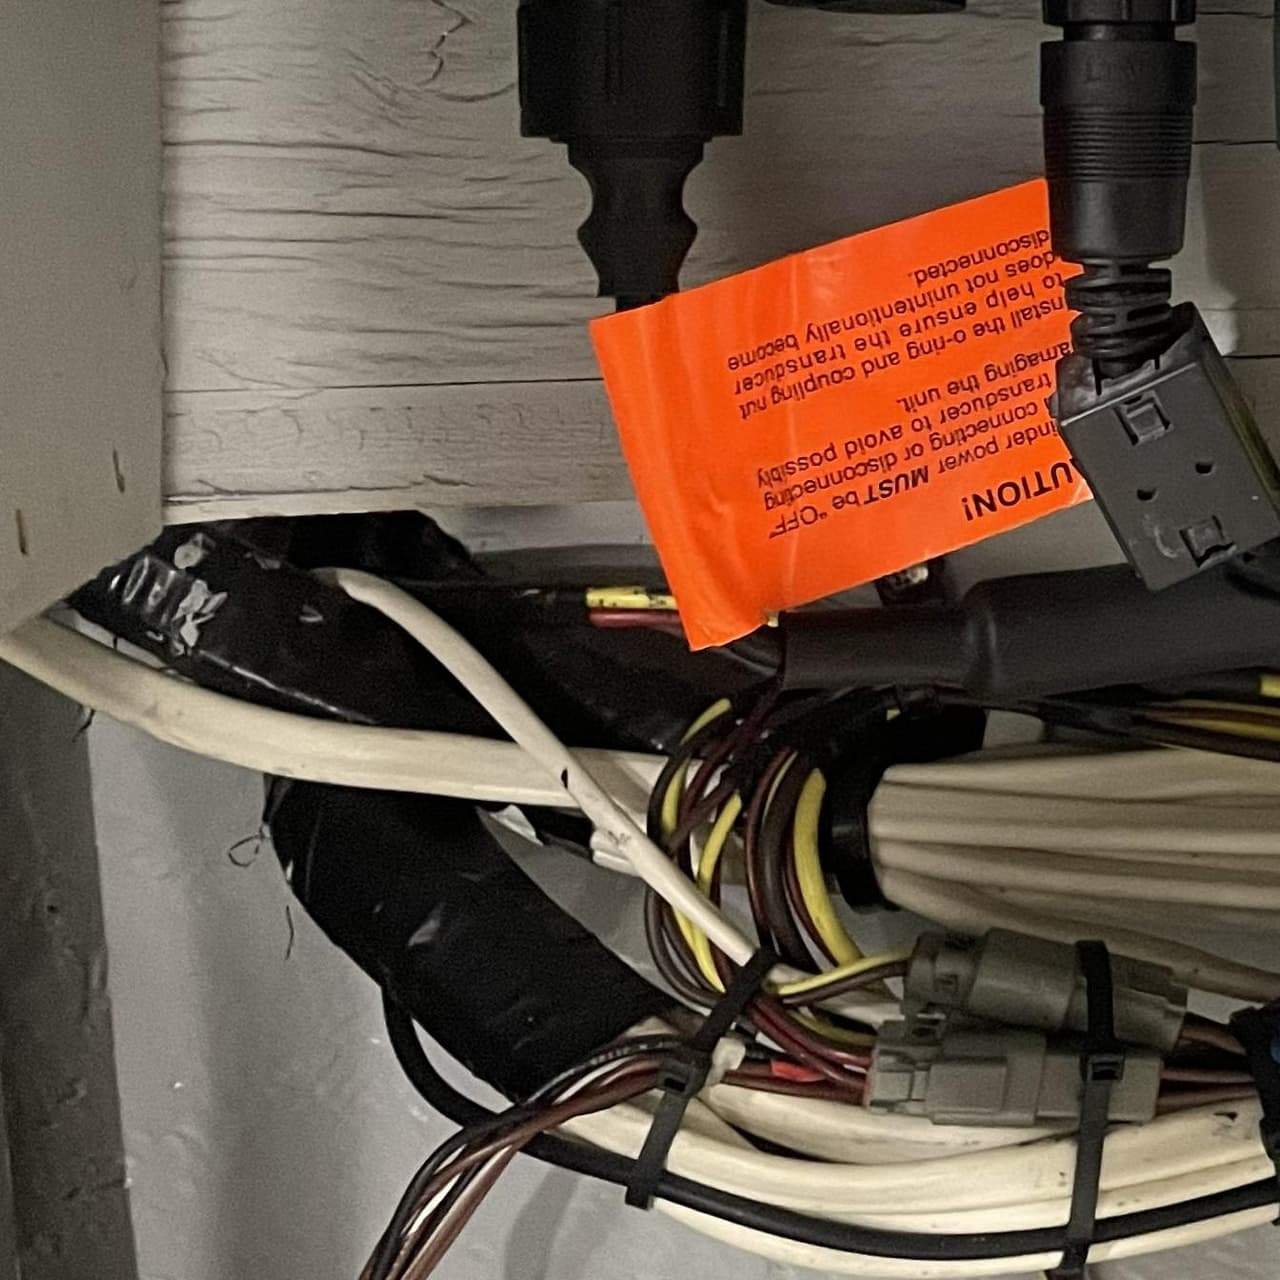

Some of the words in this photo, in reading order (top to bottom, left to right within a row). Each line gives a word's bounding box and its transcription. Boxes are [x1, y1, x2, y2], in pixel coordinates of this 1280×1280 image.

[908, 229, 1050, 288] disconnected.
[1005, 251, 1055, 277] does
[965, 269, 999, 293] not
[985, 282, 1035, 308] help
[1042, 272, 1065, 290] to
[805, 283, 960, 343] unintentionally
[899, 302, 977, 337] ensure
[972, 318, 1006, 337] the
[1012, 296, 1065, 329] nstall
[727, 334, 800, 370] become
[854, 330, 891, 351] the
[906, 329, 967, 360] o-ring
[735, 344, 846, 396] transducer
[861, 351, 901, 379] and
[984, 341, 1073, 383] amaging
[771, 366, 856, 405] coupling
[896, 387, 942, 413] unit.
[940, 372, 1052, 424] transducer
[947, 374, 980, 395] the
[739, 396, 767, 420] nut
[911, 415, 932, 433] to
[844, 424, 903, 459] avoid
[929, 401, 1038, 451] connecting
[1005, 420, 1059, 450] inder
[757, 442, 837, 488] possibly
[903, 442, 924, 461] or
[937, 435, 1000, 474] power
[764, 452, 898, 511] disconnecting
[863, 465, 929, 505] MUST
[961, 461, 1074, 522] UTION!
[832, 490, 860, 510] be
